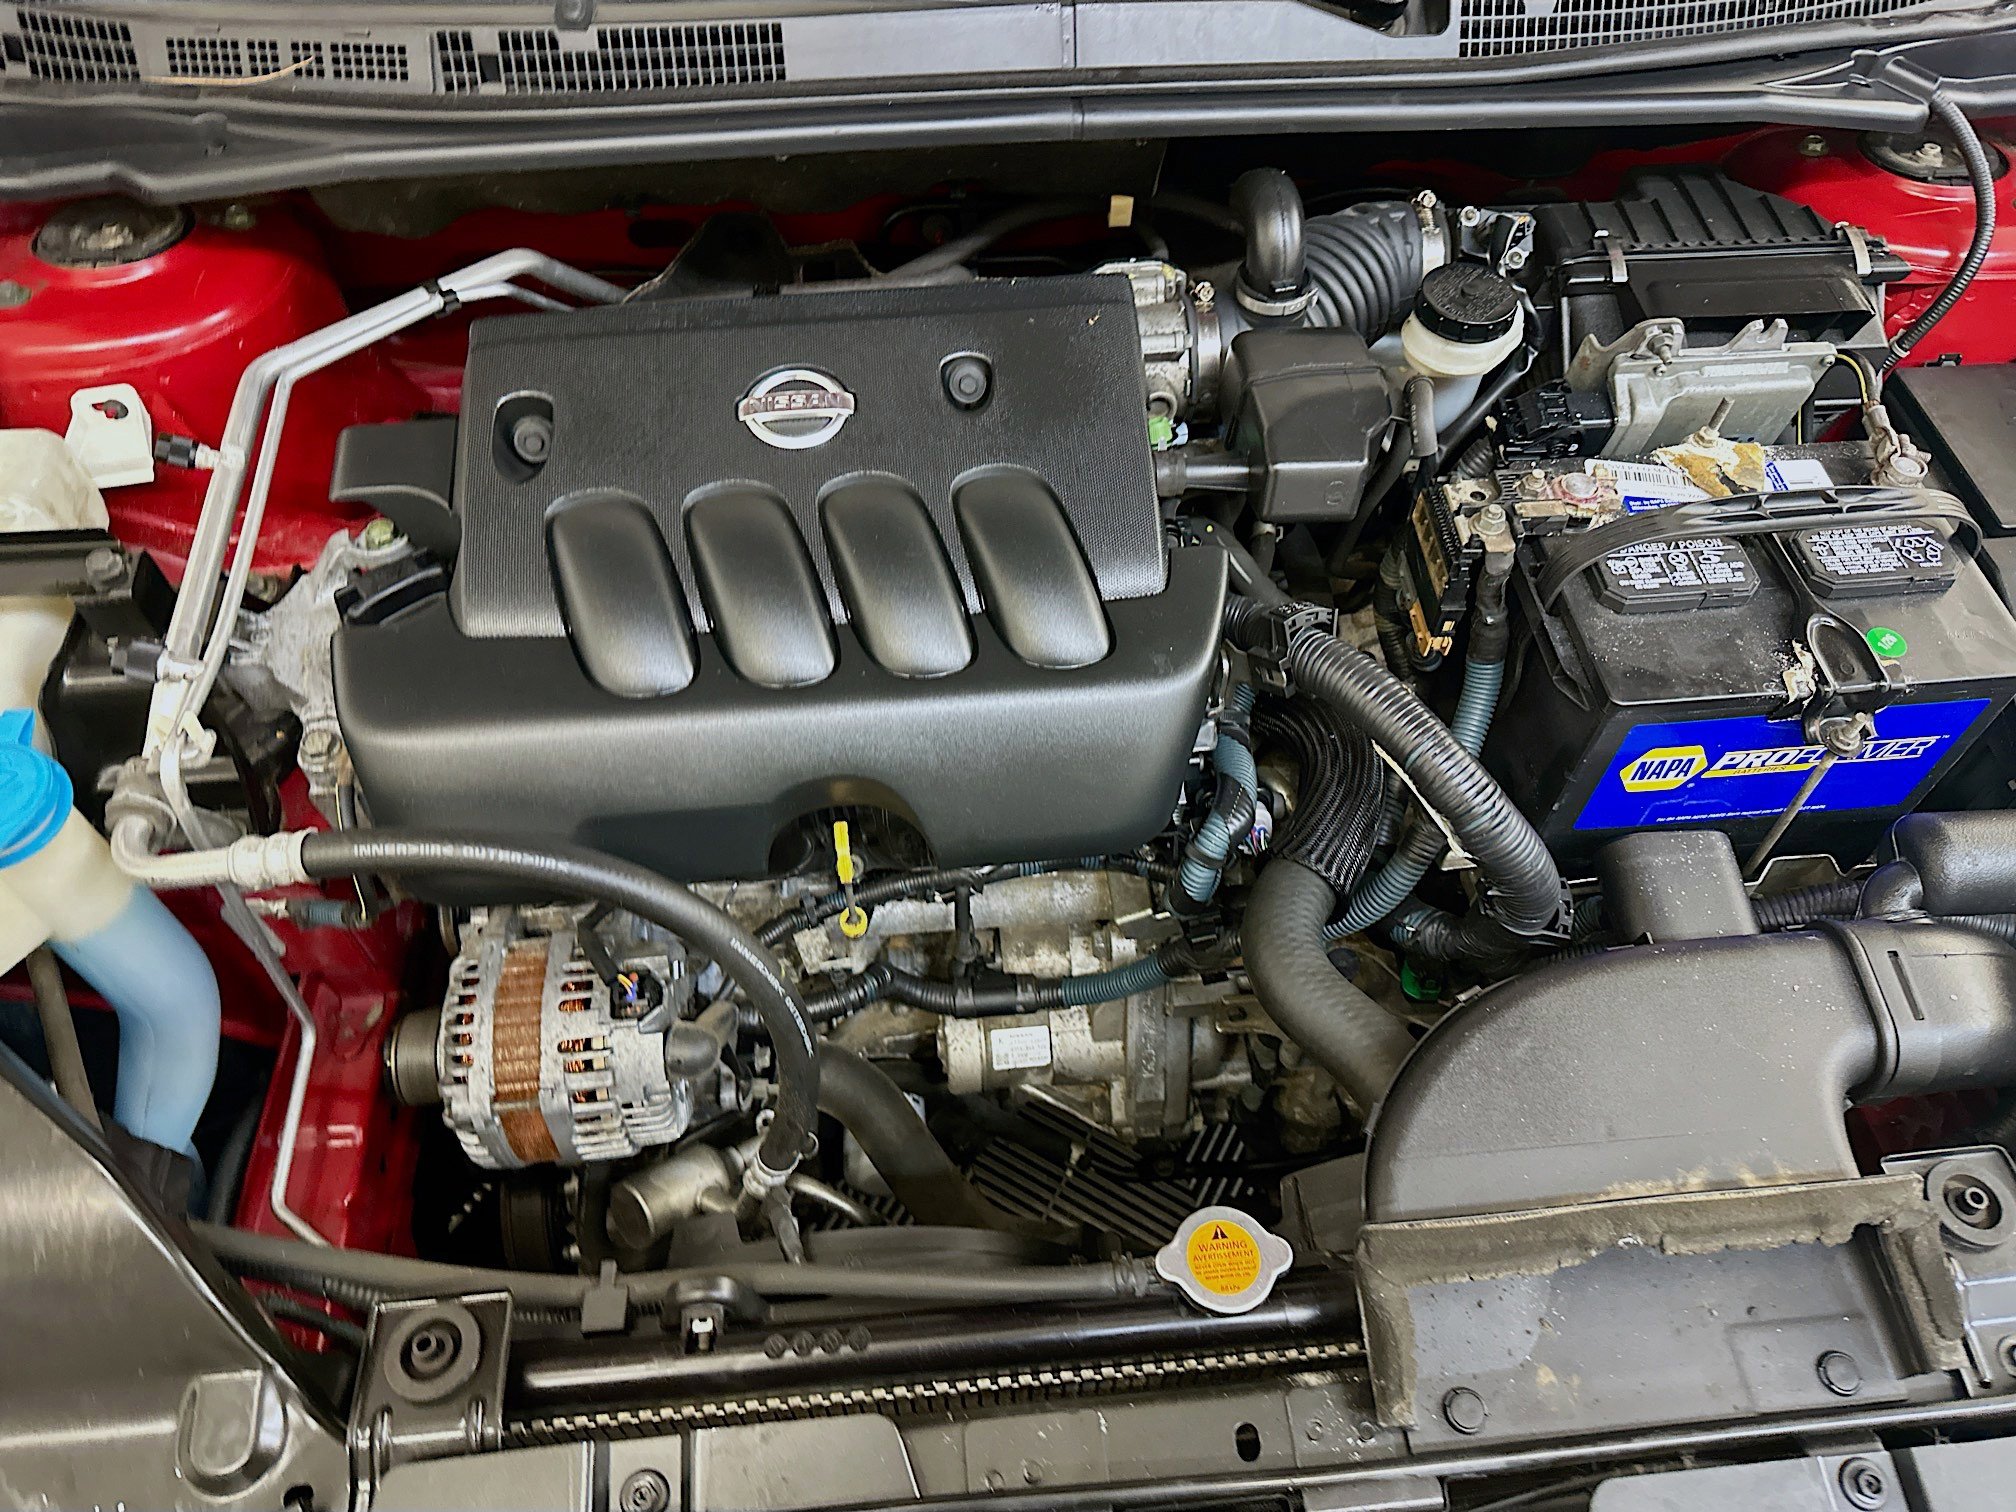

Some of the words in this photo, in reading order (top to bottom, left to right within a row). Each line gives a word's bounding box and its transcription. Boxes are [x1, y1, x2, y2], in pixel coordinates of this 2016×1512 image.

[749, 392, 840, 413] NISSAN
[1678, 538, 1723, 549] POISON
[1630, 757, 1696, 781] NAPA
[1733, 765, 1788, 775] BATTERIES
[1198, 1240, 1247, 1252] WARNING
[1193, 1250, 1254, 1262] AVERTISSEMENT
